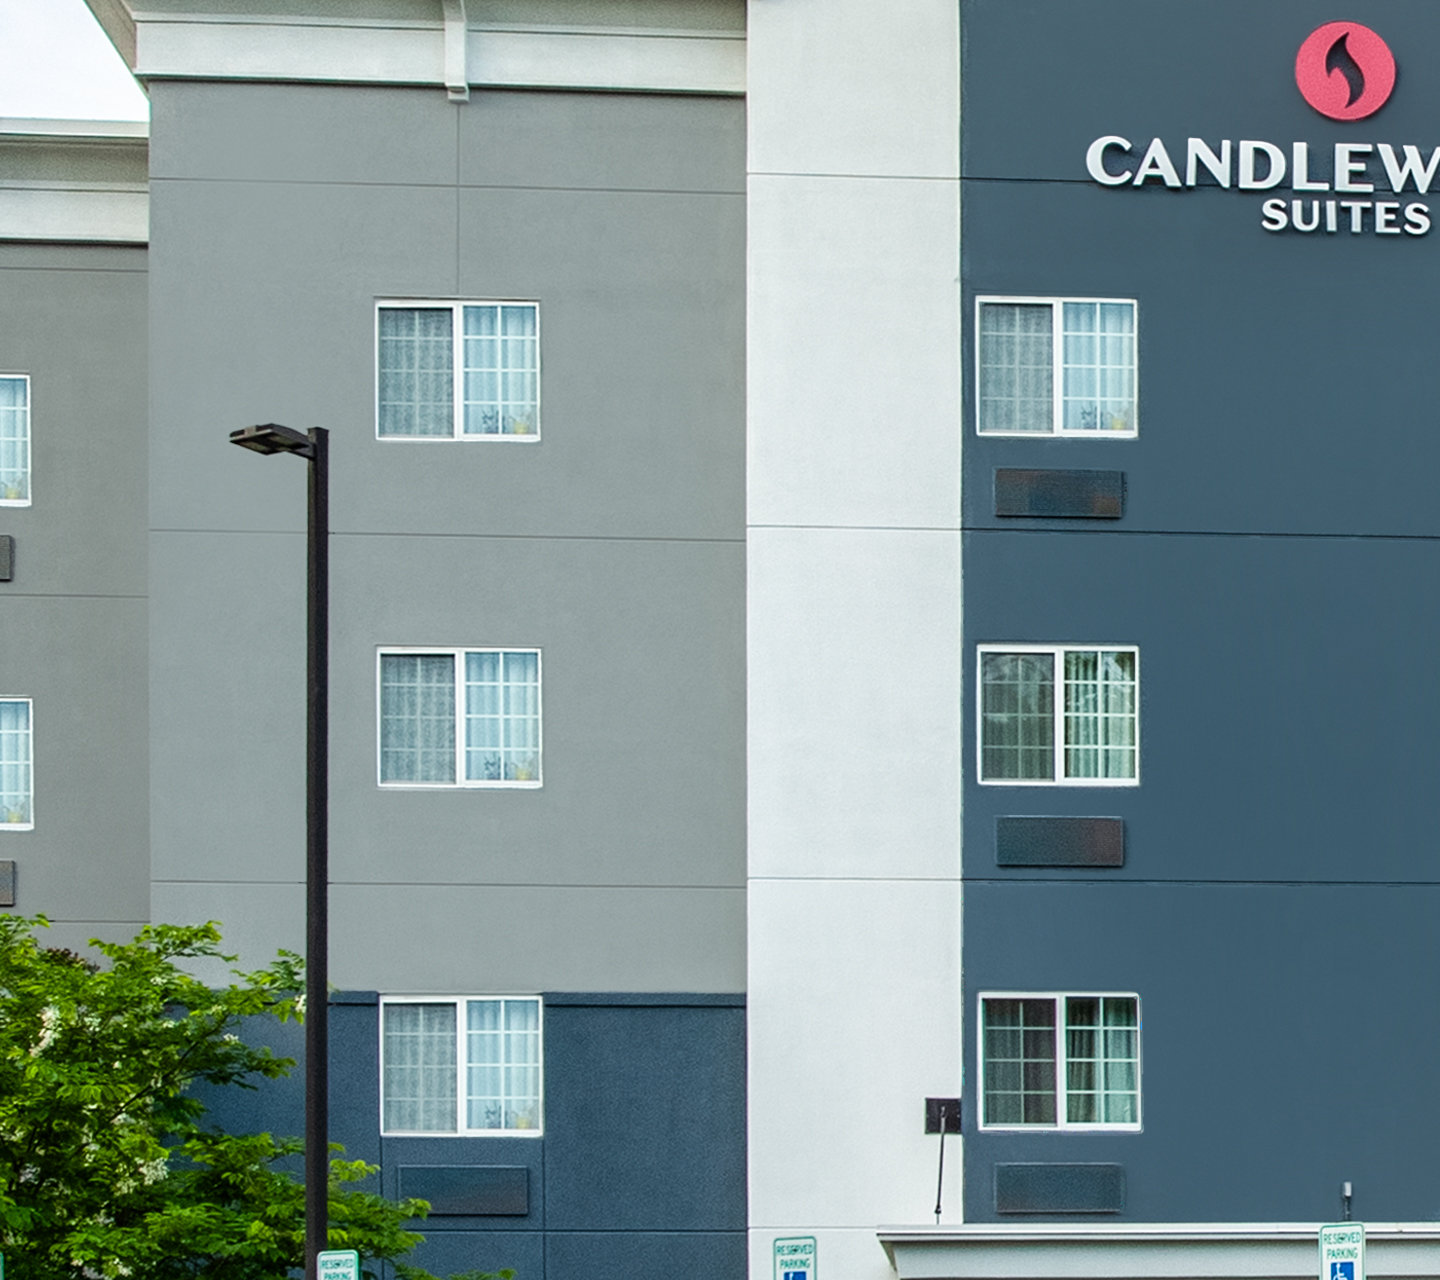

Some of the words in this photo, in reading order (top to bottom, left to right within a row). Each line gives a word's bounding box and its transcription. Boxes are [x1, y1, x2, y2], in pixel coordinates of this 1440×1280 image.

[1261, 198, 1432, 236] SUITES
[1323, 1231, 1360, 1245] RESERVED
[776, 1244, 813, 1256] RESERVED
[1327, 1247, 1358, 1259] PARKING
[321, 1258, 354, 1269] RESERVED
[780, 1258, 810, 1269] PARKING
